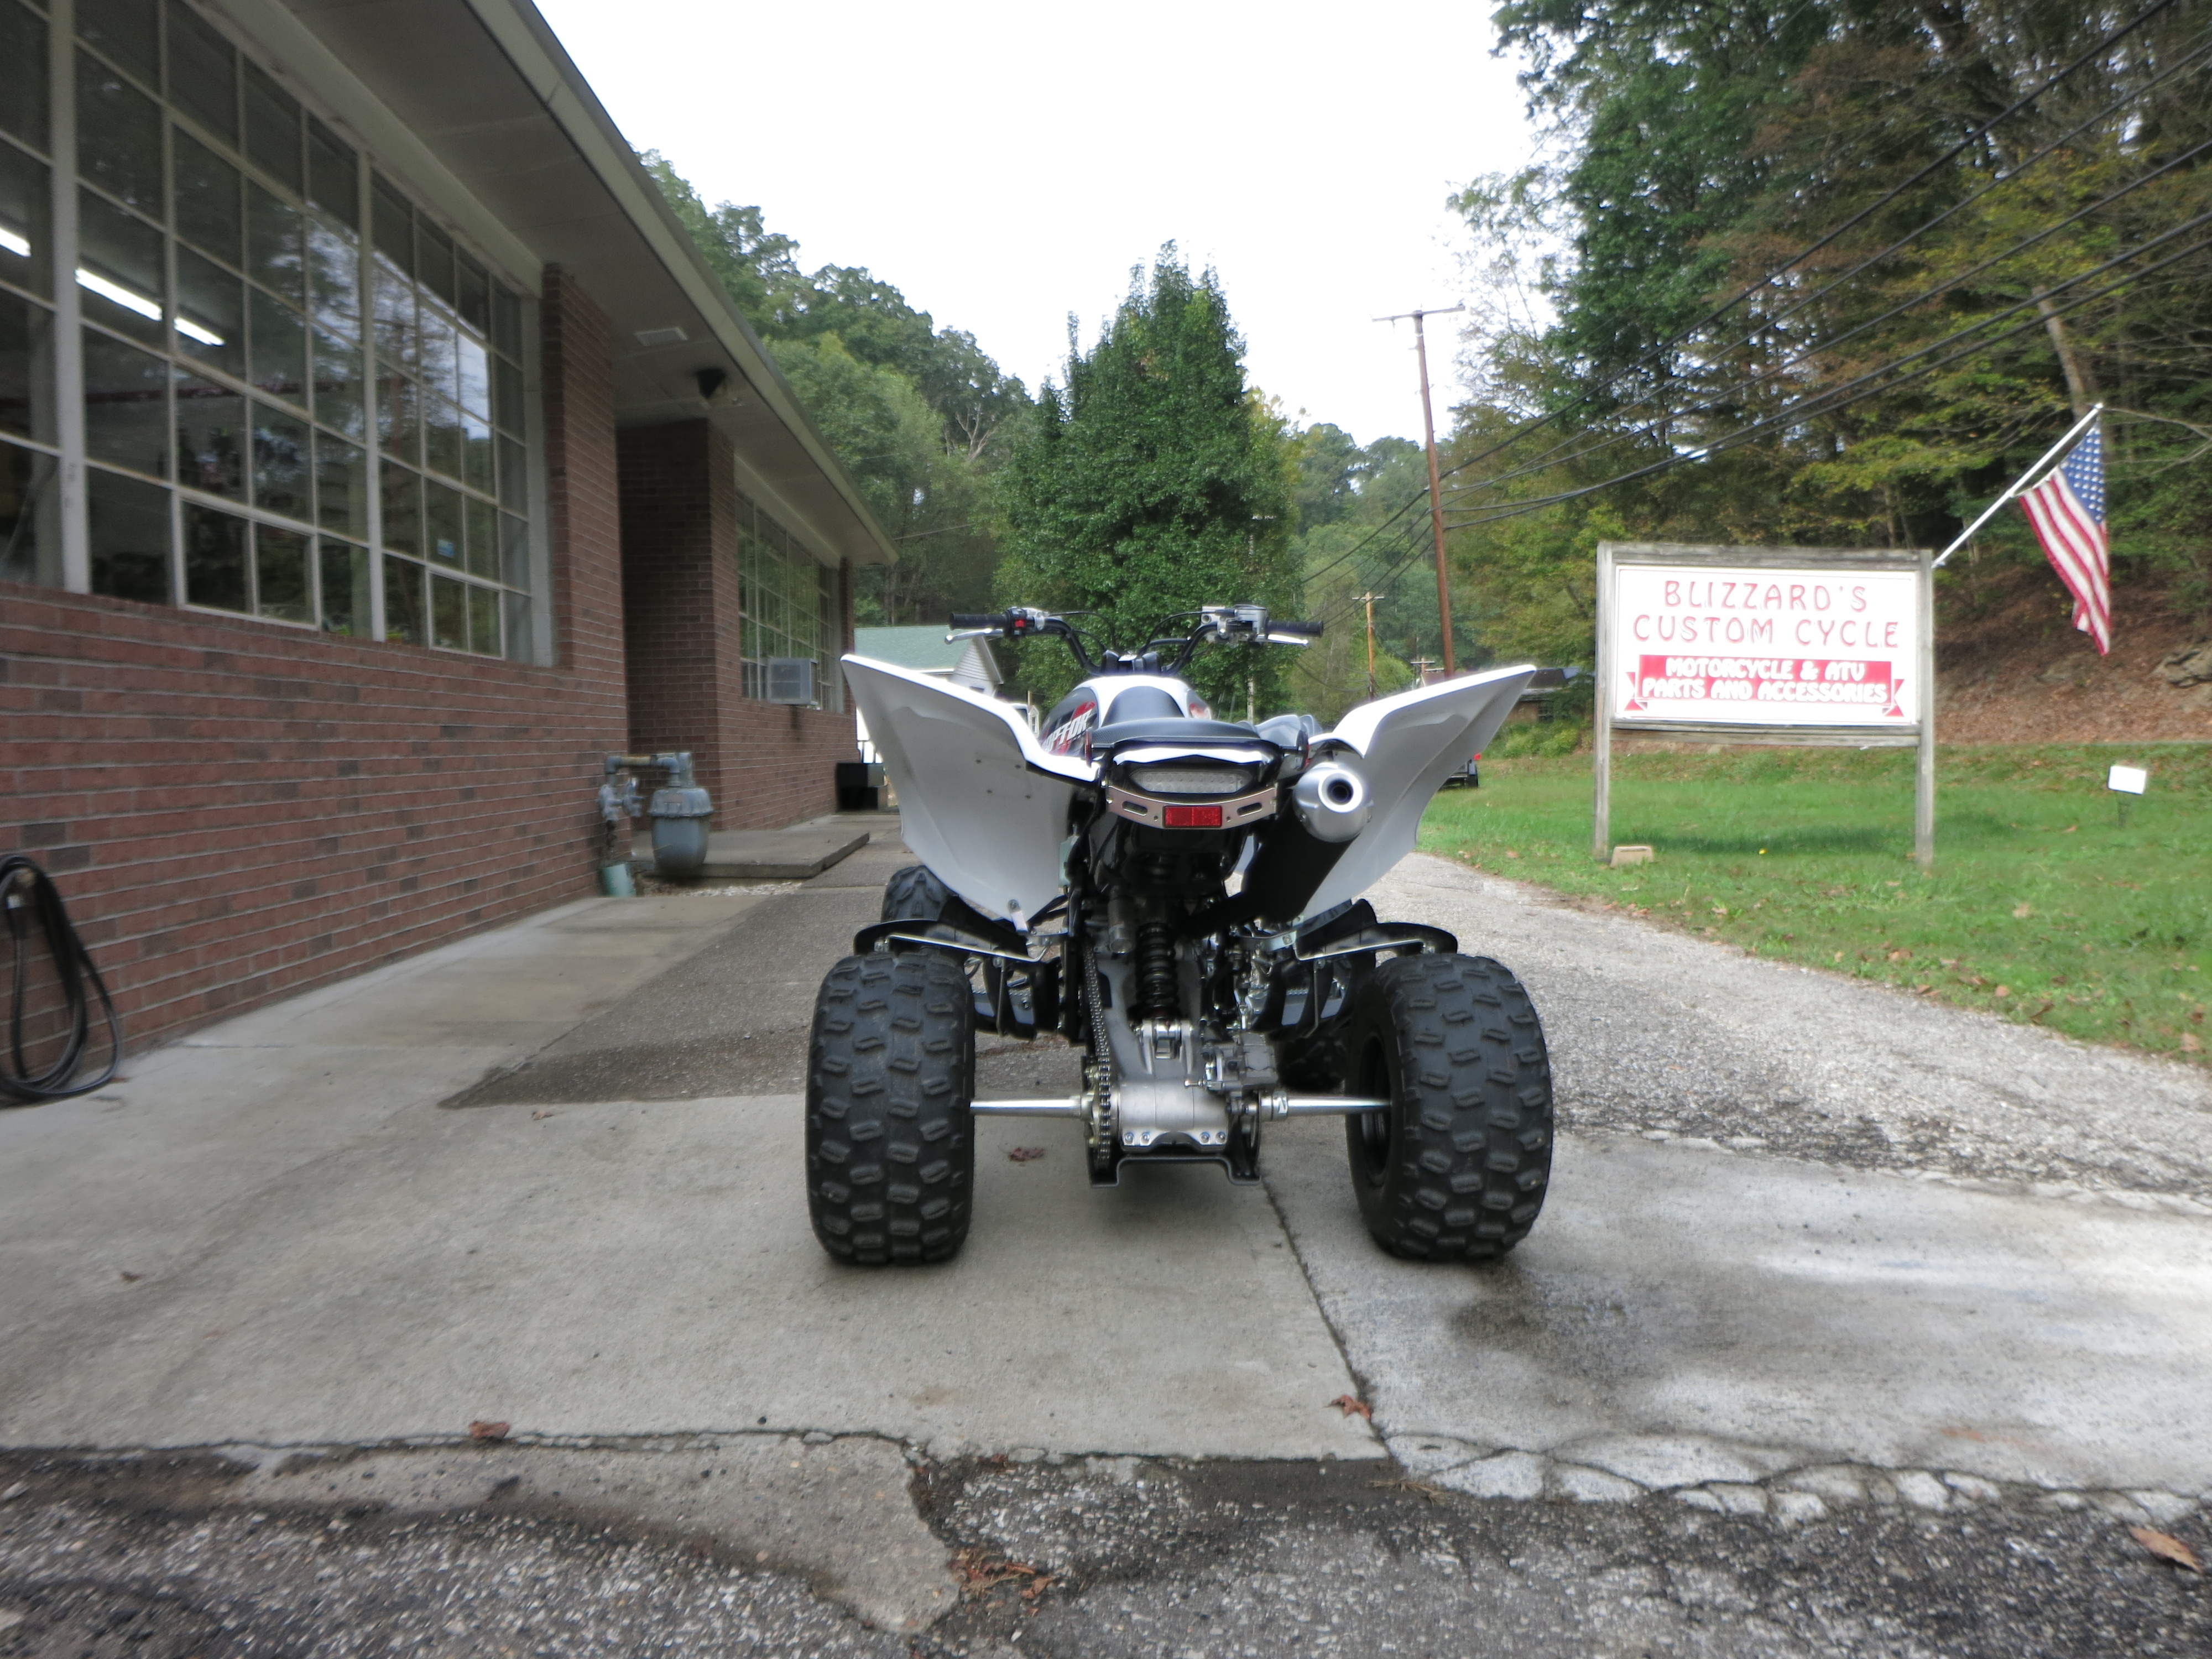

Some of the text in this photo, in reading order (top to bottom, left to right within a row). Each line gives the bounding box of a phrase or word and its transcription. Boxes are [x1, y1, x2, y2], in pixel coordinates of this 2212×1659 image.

[1664, 580, 1867, 613] BLIZZARD'S
[1632, 614, 1899, 648] CUSTOM CYCLE
[1665, 657, 1866, 681] MOTORCYCLE & ATV
[1641, 677, 1888, 703] PARTS AND ACCESSORIES
[1042, 708, 1092, 753] APTOR
